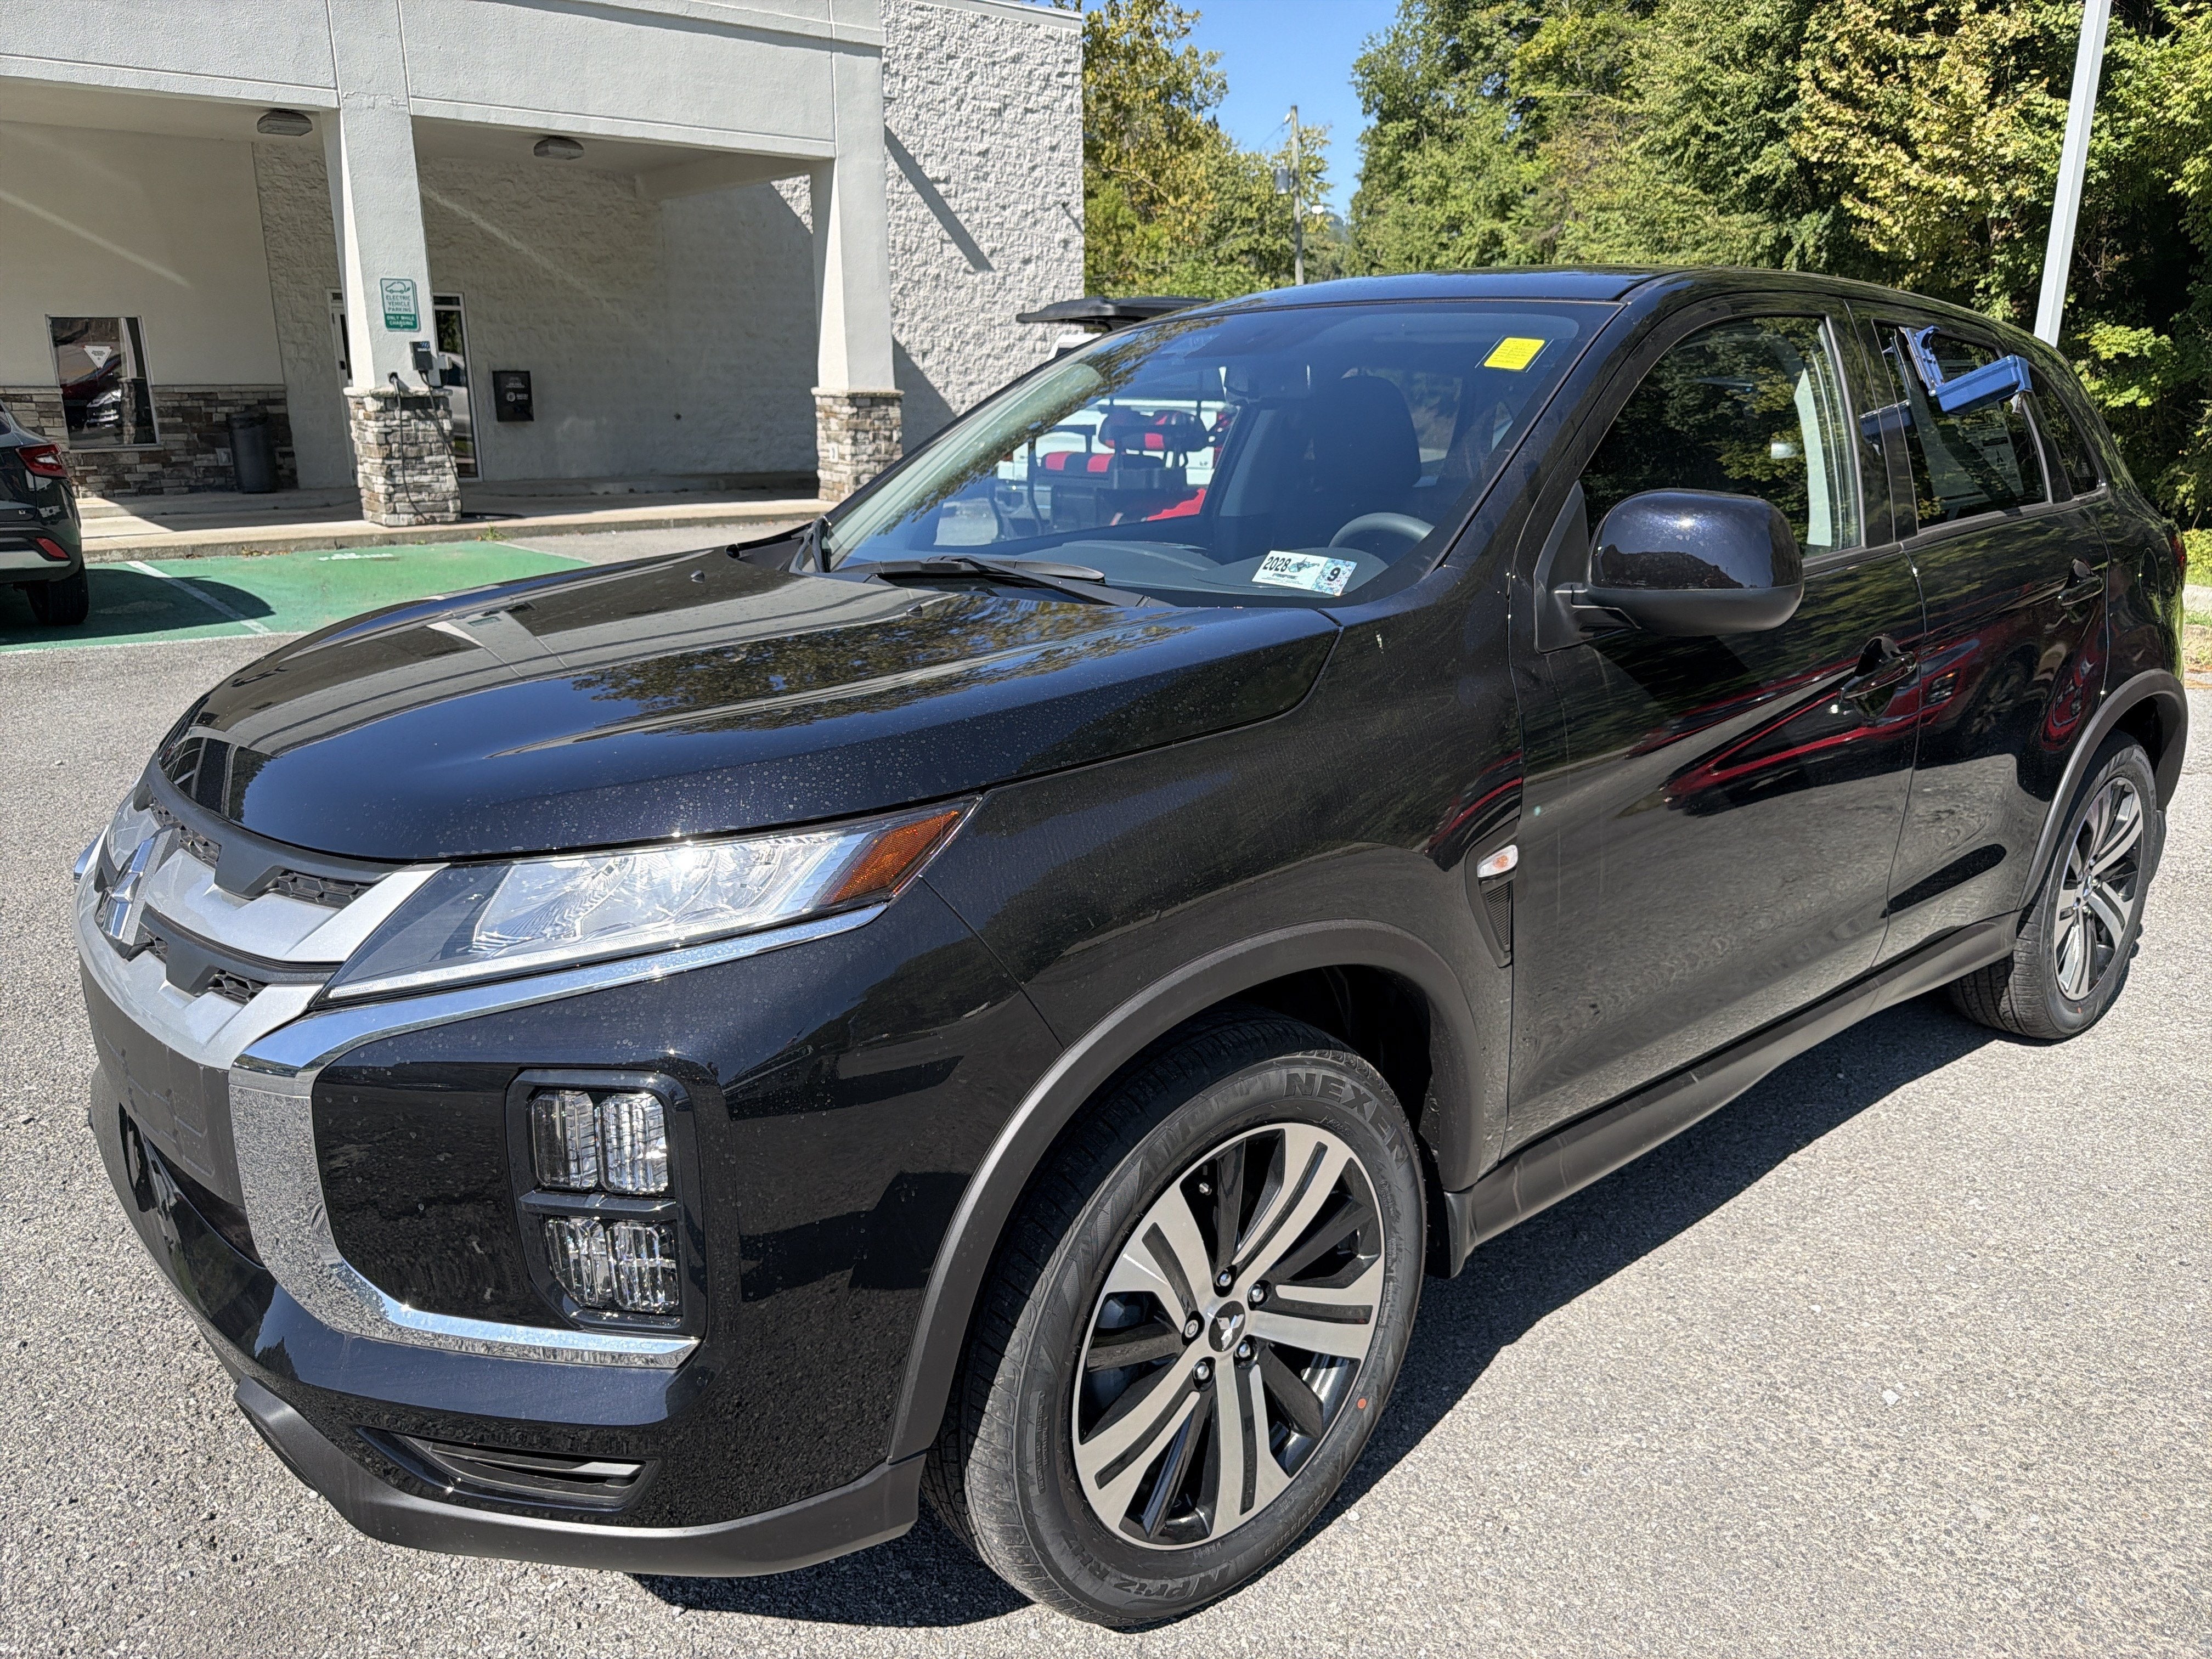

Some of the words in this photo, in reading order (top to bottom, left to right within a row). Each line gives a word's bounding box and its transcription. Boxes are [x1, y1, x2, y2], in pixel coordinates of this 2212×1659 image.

[1262, 556, 1292, 572] 2028
[1327, 567, 1341, 582] 9
[1283, 1071, 1410, 1170] NEXEN
